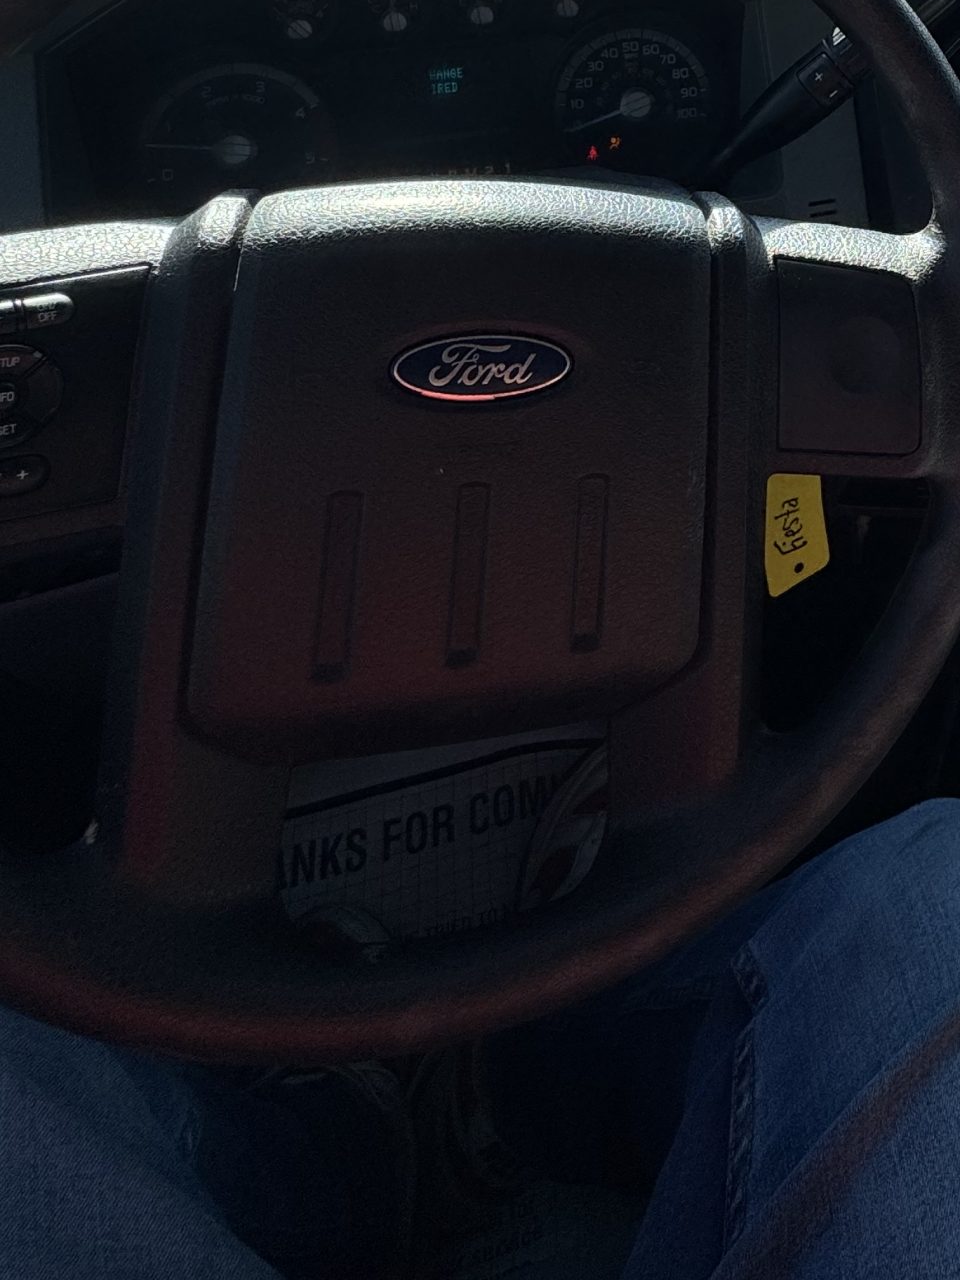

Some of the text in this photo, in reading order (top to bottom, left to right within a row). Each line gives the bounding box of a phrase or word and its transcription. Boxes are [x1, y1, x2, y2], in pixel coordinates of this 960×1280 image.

[600, 47, 619, 59] 40
[621, 41, 640, 53] 50
[642, 43, 660, 55] 60
[659, 53, 677, 65] 70
[586, 60, 605, 72] 30
[671, 67, 689, 79] 80
[575, 77, 593, 89] 20
[680, 87, 698, 98] 90
[570, 98, 585, 110] 10
[428, 343, 537, 387] Ford
[772, 495, 809, 556] Fiesta
[381, 804, 456, 862] FOR
[470, 772, 562, 835] COM
